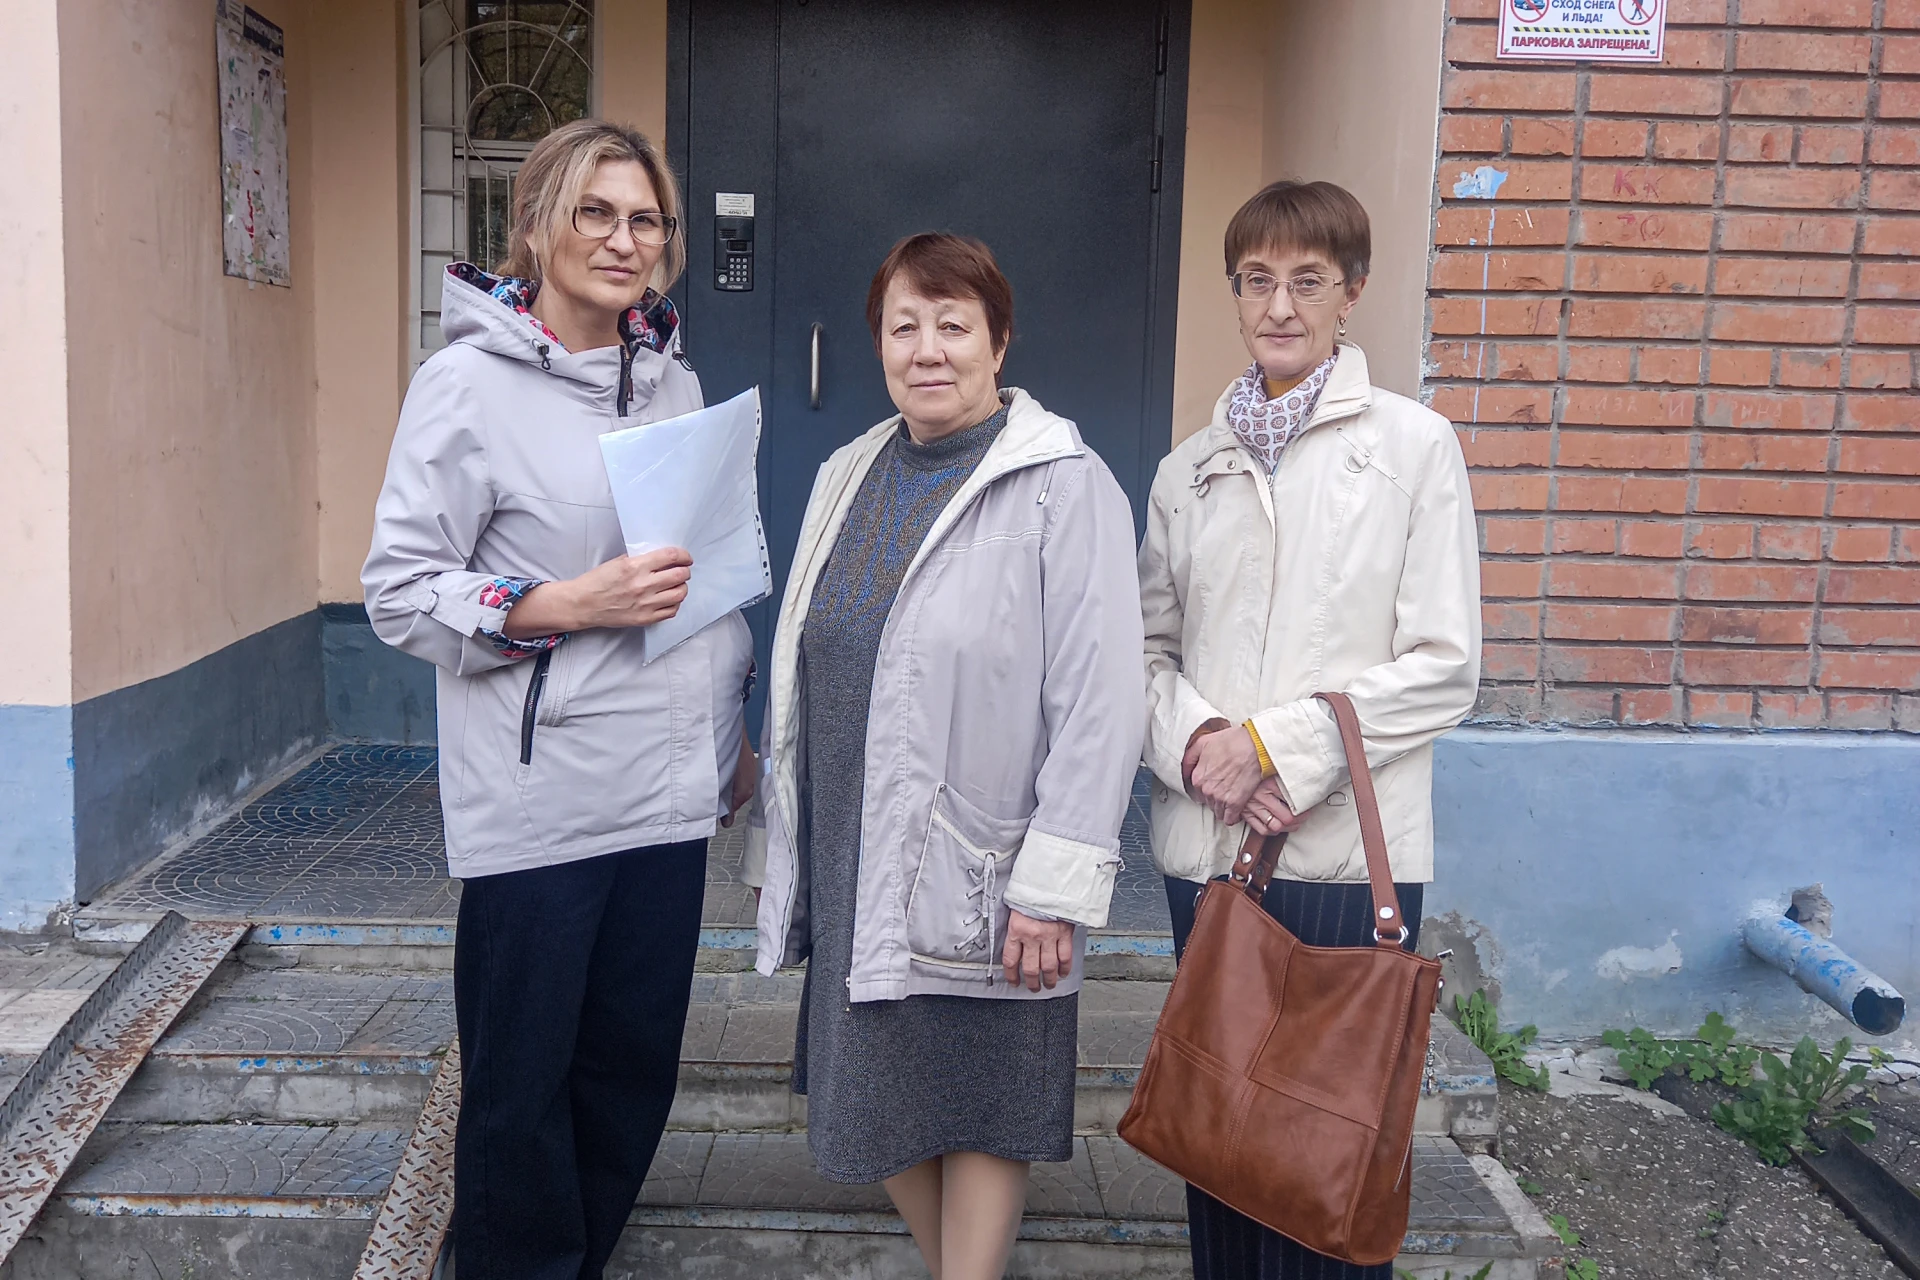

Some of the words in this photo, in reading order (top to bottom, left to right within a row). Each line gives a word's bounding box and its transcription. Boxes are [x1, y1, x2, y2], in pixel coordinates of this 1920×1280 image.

[1551, 0, 1581, 10] СХОД
[1583, 0, 1615, 10] СНЕГА
[1562, 13, 1570, 21] И
[1571, 13, 1603, 23] ЛЬДА!
[1511, 36, 1575, 48] ПАРКОВКА
[1577, 38, 1650, 51] ЗАПРЕЩЕНА!
